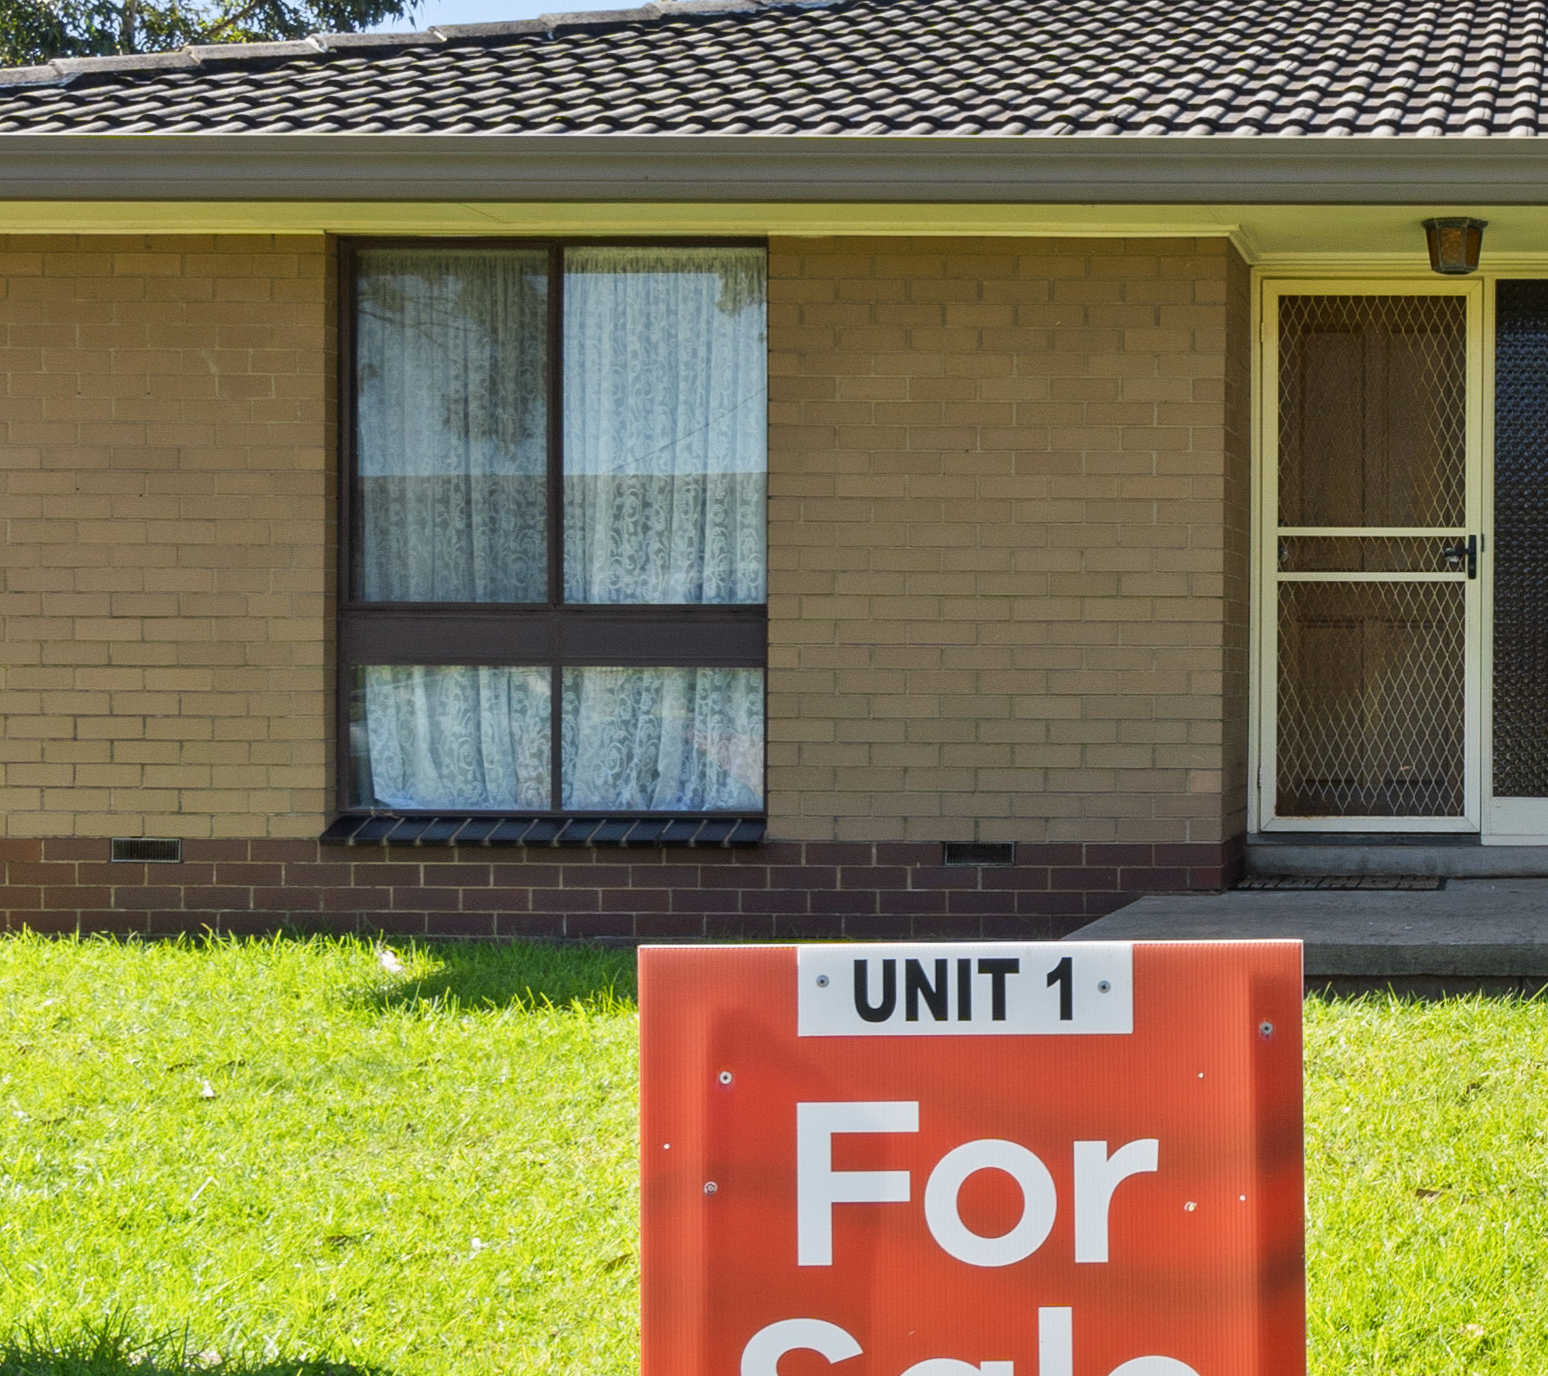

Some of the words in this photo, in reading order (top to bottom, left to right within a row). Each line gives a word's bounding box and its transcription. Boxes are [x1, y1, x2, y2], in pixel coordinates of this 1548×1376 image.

[853, 958, 1020, 1023] UNIT
[1045, 957, 1074, 1021] 1
[796, 1101, 1160, 1267] For
